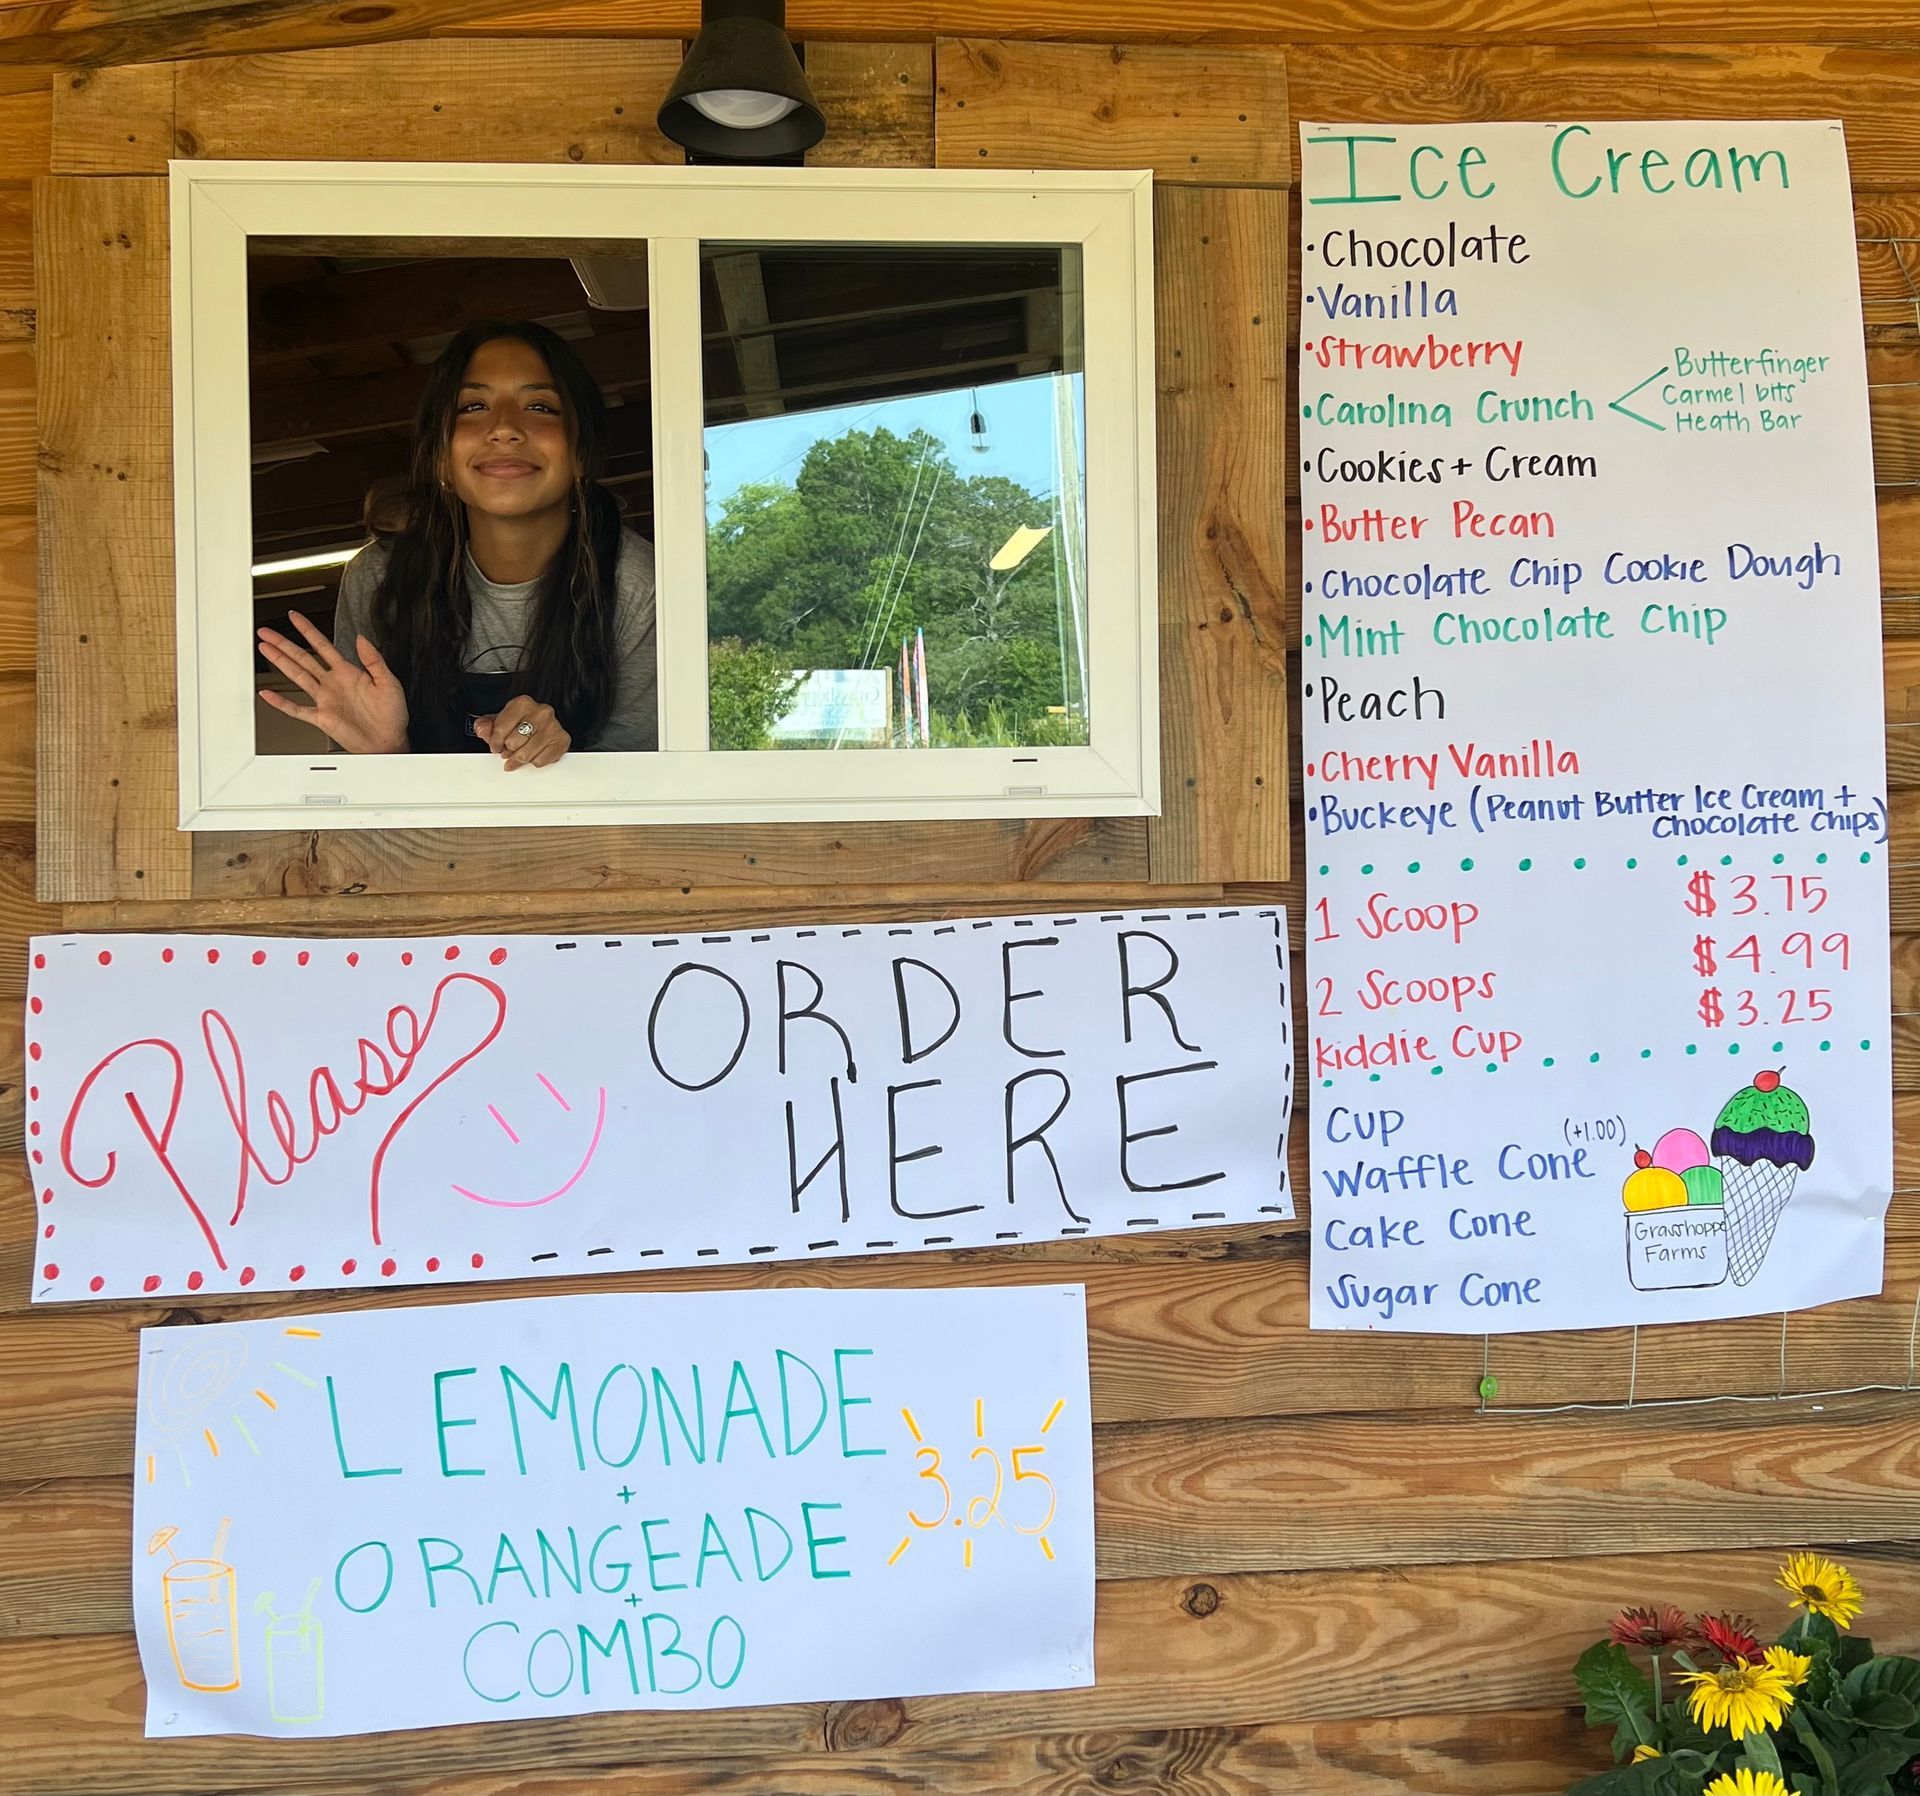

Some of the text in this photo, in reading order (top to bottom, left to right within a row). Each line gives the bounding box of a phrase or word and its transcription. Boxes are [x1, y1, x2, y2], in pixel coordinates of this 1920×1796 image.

[1312, 129, 1787, 202] Ice Cream
[1325, 224, 1528, 265] Chocolate
[1319, 283, 1455, 317] Vanilla
[1313, 336, 1520, 374] Strawberry
[1677, 349, 1827, 383] Butterfinger
[1319, 392, 1591, 425] Carolina Crunch
[1665, 384, 1793, 403] Carmel bits
[1679, 412, 1799, 430] Heath Bar
[1488, 448, 1594, 479] Cream
[1323, 502, 1552, 541] Butter Pecan
[1324, 544, 1838, 598] Chocolate Chip Cookie Dough
[1321, 606, 1725, 656] Mint Chocolate Chip
[1323, 678, 1442, 721] Peach
[1324, 741, 1577, 788] Cherry Vanilla
[1323, 797, 1455, 833] Buckeye
[1472, 787, 1583, 831] (Peanut
[1597, 791, 1683, 818] Butter
[1697, 787, 1730, 811] Ice
[1744, 786, 1827, 812] Cream
[1651, 811, 1797, 836] Chocolate
[1317, 899, 1338, 939] 1
[1358, 895, 1476, 941] Scoop
[648, 930, 1203, 1091] ORDER
[1318, 972, 1494, 1013] 2 Scoops
[1455, 1027, 1519, 1064] Cup
[60, 972, 507, 1271] Please
[1329, 1109, 1402, 1145] Cup
[1324, 1141, 1594, 1195] Waffle Cone
[1327, 1211, 1534, 1249] Cake Cone
[1647, 1246, 1705, 1261] Farms
[1328, 1275, 1539, 1317] Sugar Cone
[328, 1350, 885, 1477] LEMONADE
[911, 1448, 1051, 1526] 3.25
[335, 1502, 851, 1613] ORANGEADE
[465, 1615, 744, 1701] COMBO
